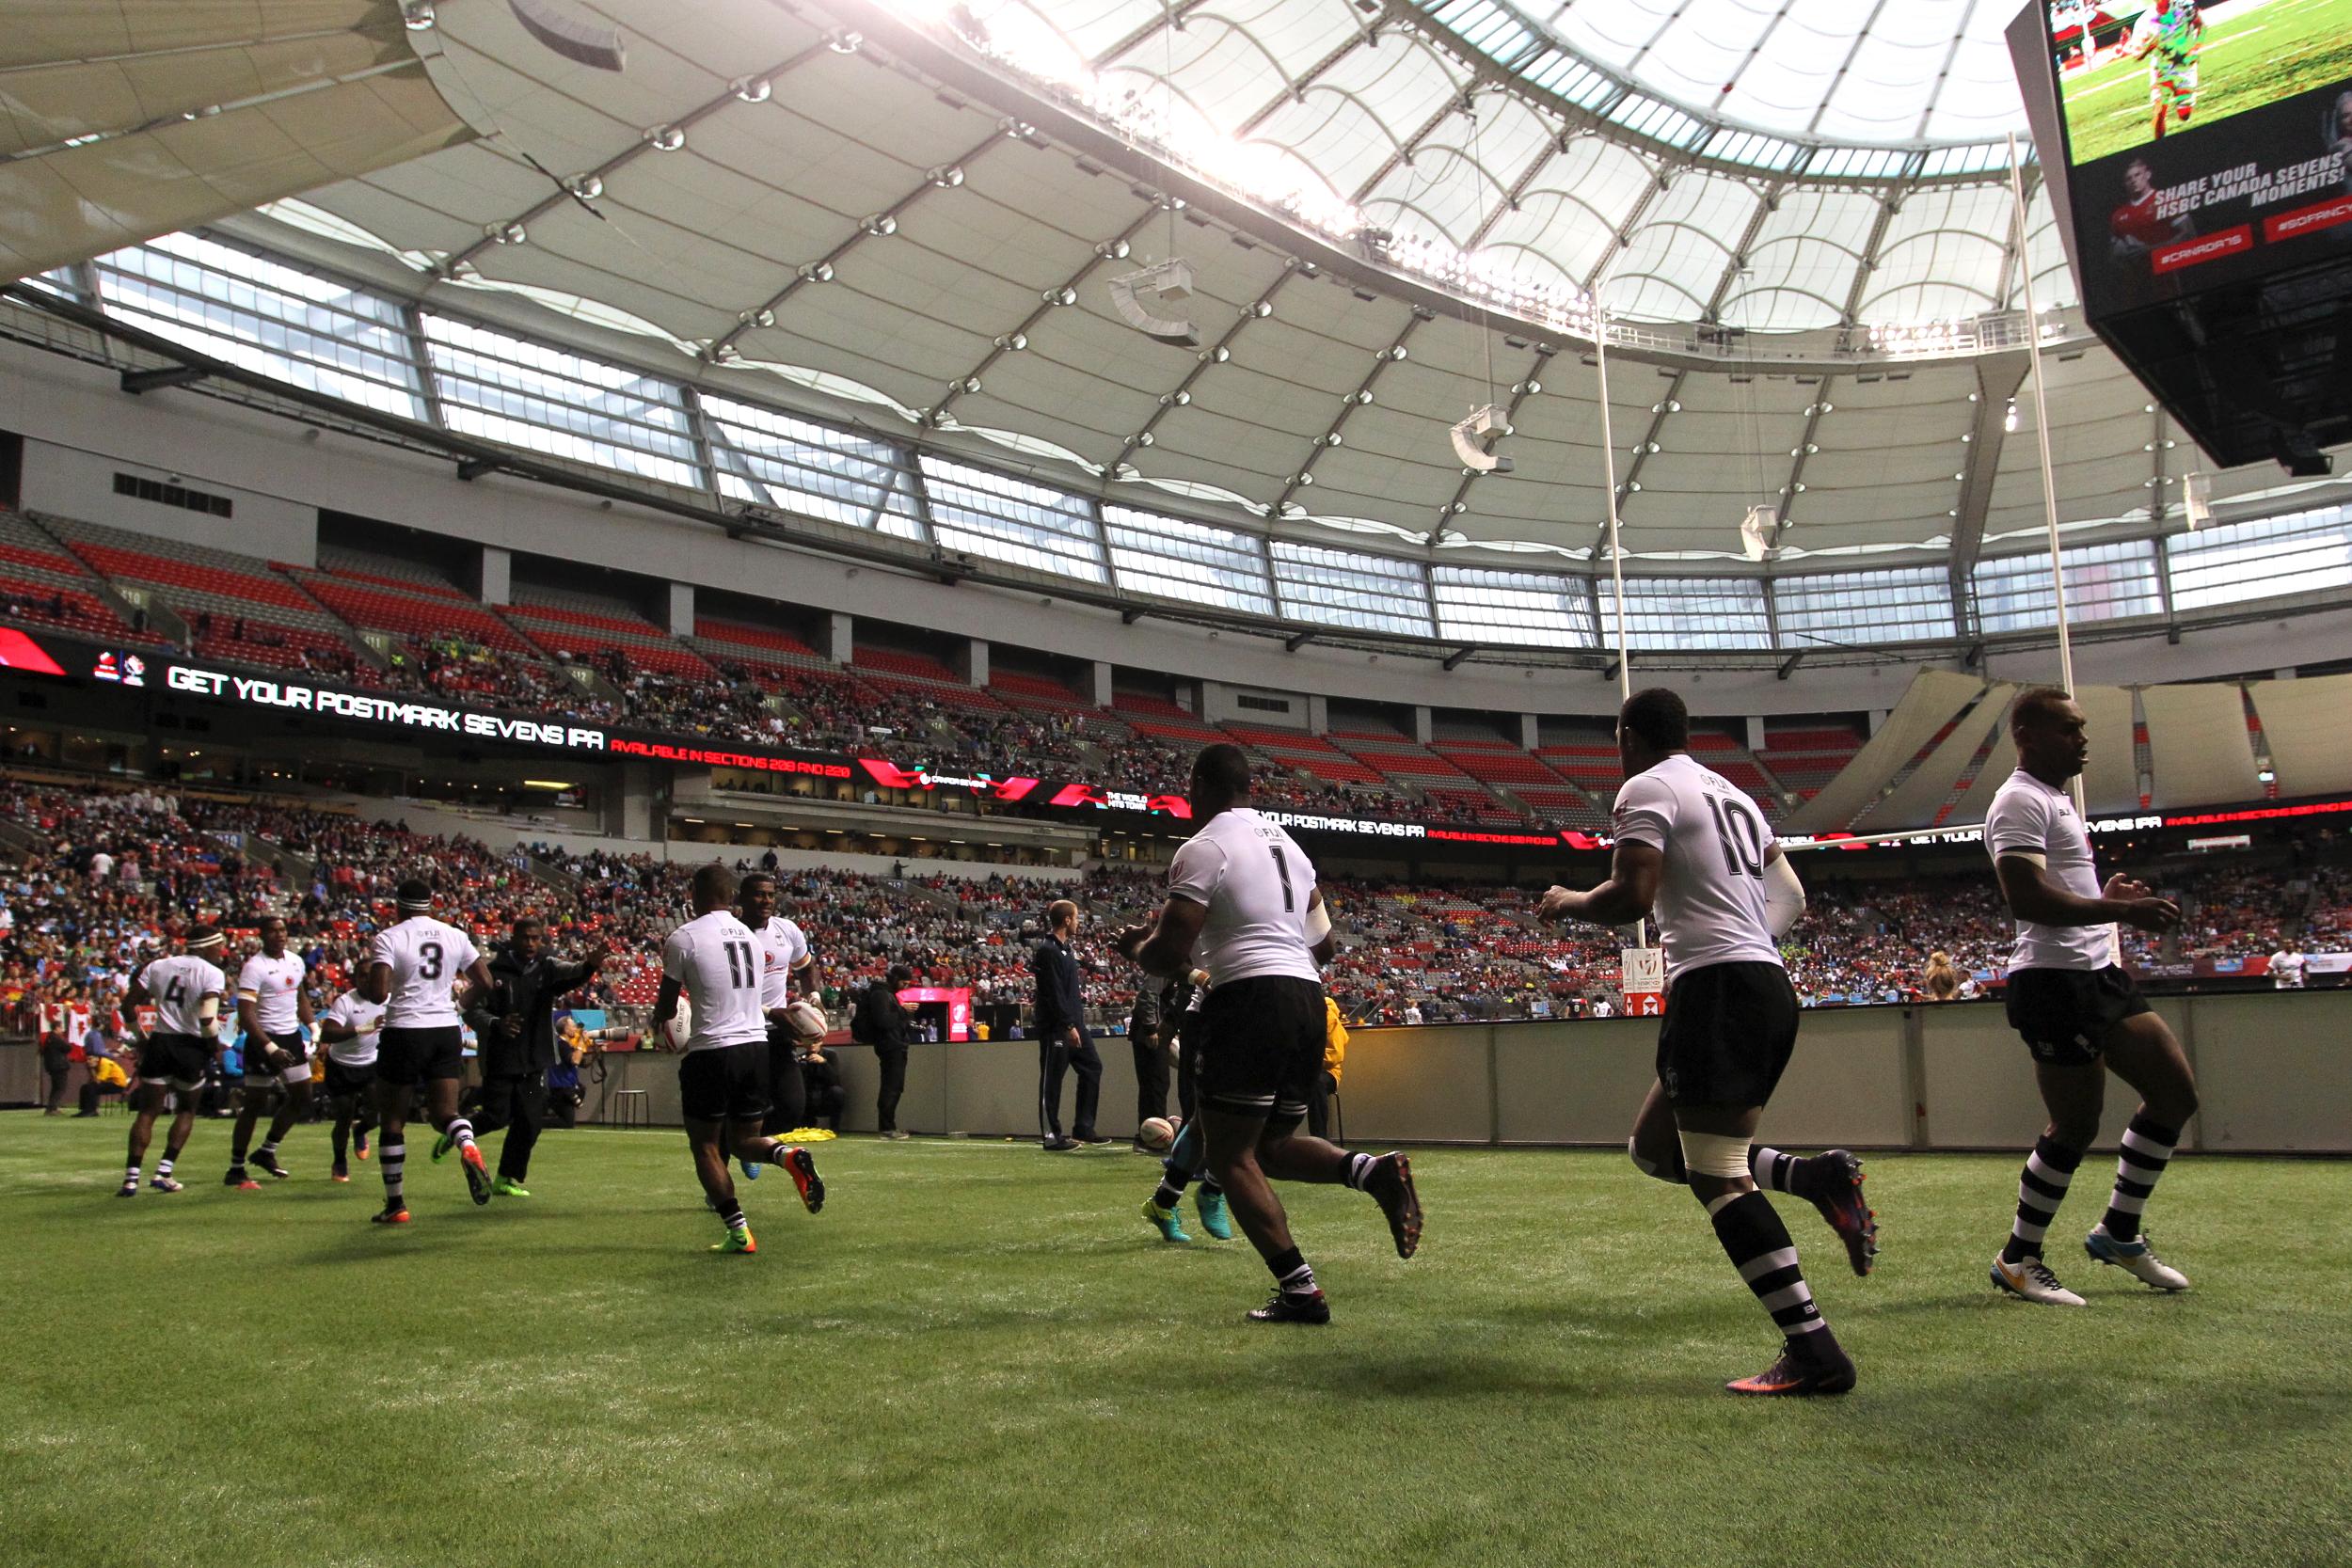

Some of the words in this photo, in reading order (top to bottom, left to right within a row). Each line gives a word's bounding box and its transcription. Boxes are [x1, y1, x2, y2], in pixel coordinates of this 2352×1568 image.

[2153, 177, 2208, 205] SHARE
[2212, 163, 2257, 188] YOUR
[2156, 194, 2201, 221] HSBC
[2204, 173, 2272, 206] CANADA
[2276, 151, 2344, 184] SEVENS
[2250, 166, 2346, 208] MOMENTS!
[2161, 234, 2243, 264] #CANADA7S
[167, 665, 230, 695] GET
[232, 676, 311, 710] YOUR
[316, 690, 460, 732] POSTMARK
[464, 713, 564, 746] SEVENS
[567, 727, 604, 750] IPA
[611, 739, 688, 760] AVAILABLE
[690, 750, 703, 762] IN
[704, 752, 768, 769] SECTIONS
[797, 762, 823, 775] AND
[1106, 791, 1121, 800] THE
[1121, 794, 1148, 804] WORLD
[1261, 811, 1294, 827] YOUR
[1295, 816, 1358, 832] POSTMARK
[1358, 820, 1405, 837] SEVENS
[1406, 825, 1424, 838] IPA
[1263, 828, 1284, 839] FIJI
[1702, 792, 1764, 879] 10
[2085, 818, 2135, 833] EVENS
[2135, 816, 2162, 831] IPA
[1269, 846, 1295, 913] 1
[419, 942, 444, 980] 3
[723, 941, 755, 990] 11
[164, 974, 187, 1009] 4
